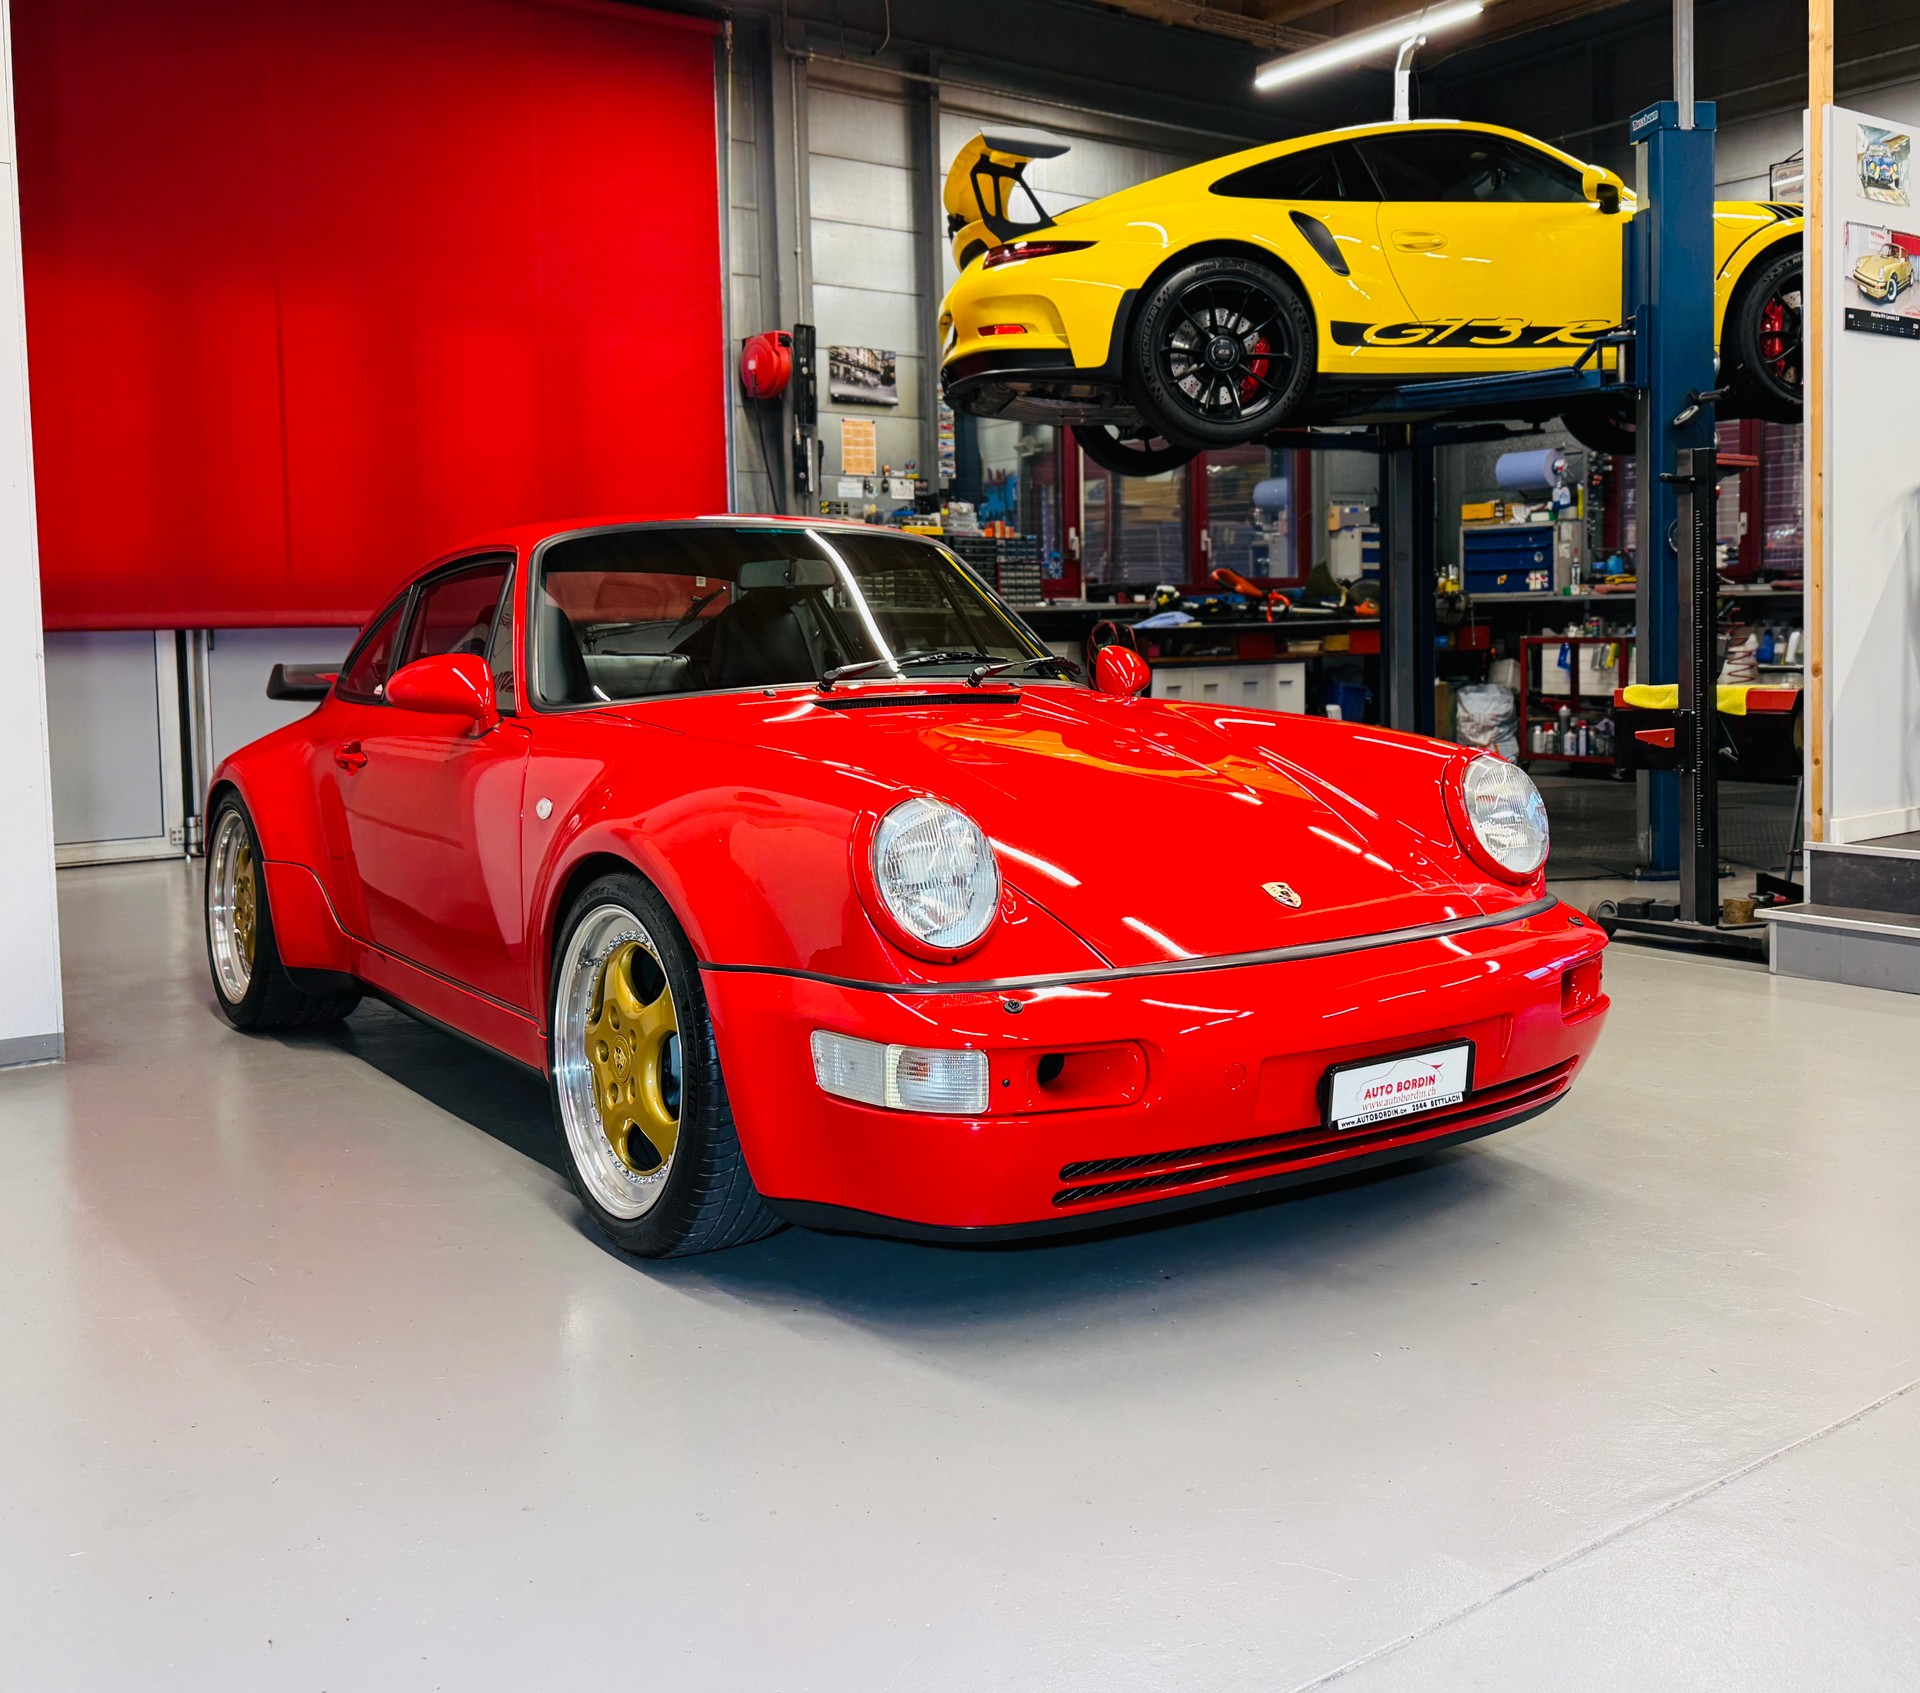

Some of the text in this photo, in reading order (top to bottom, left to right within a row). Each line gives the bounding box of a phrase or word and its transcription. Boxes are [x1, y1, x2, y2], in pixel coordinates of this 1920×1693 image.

[1363, 316, 1531, 345] GT3
[1362, 1087, 1437, 1111] www.autobordin.ch
[1364, 1074, 1436, 1100] AUTO BORDIN
[1430, 1095, 1461, 1107] BETTLACH
